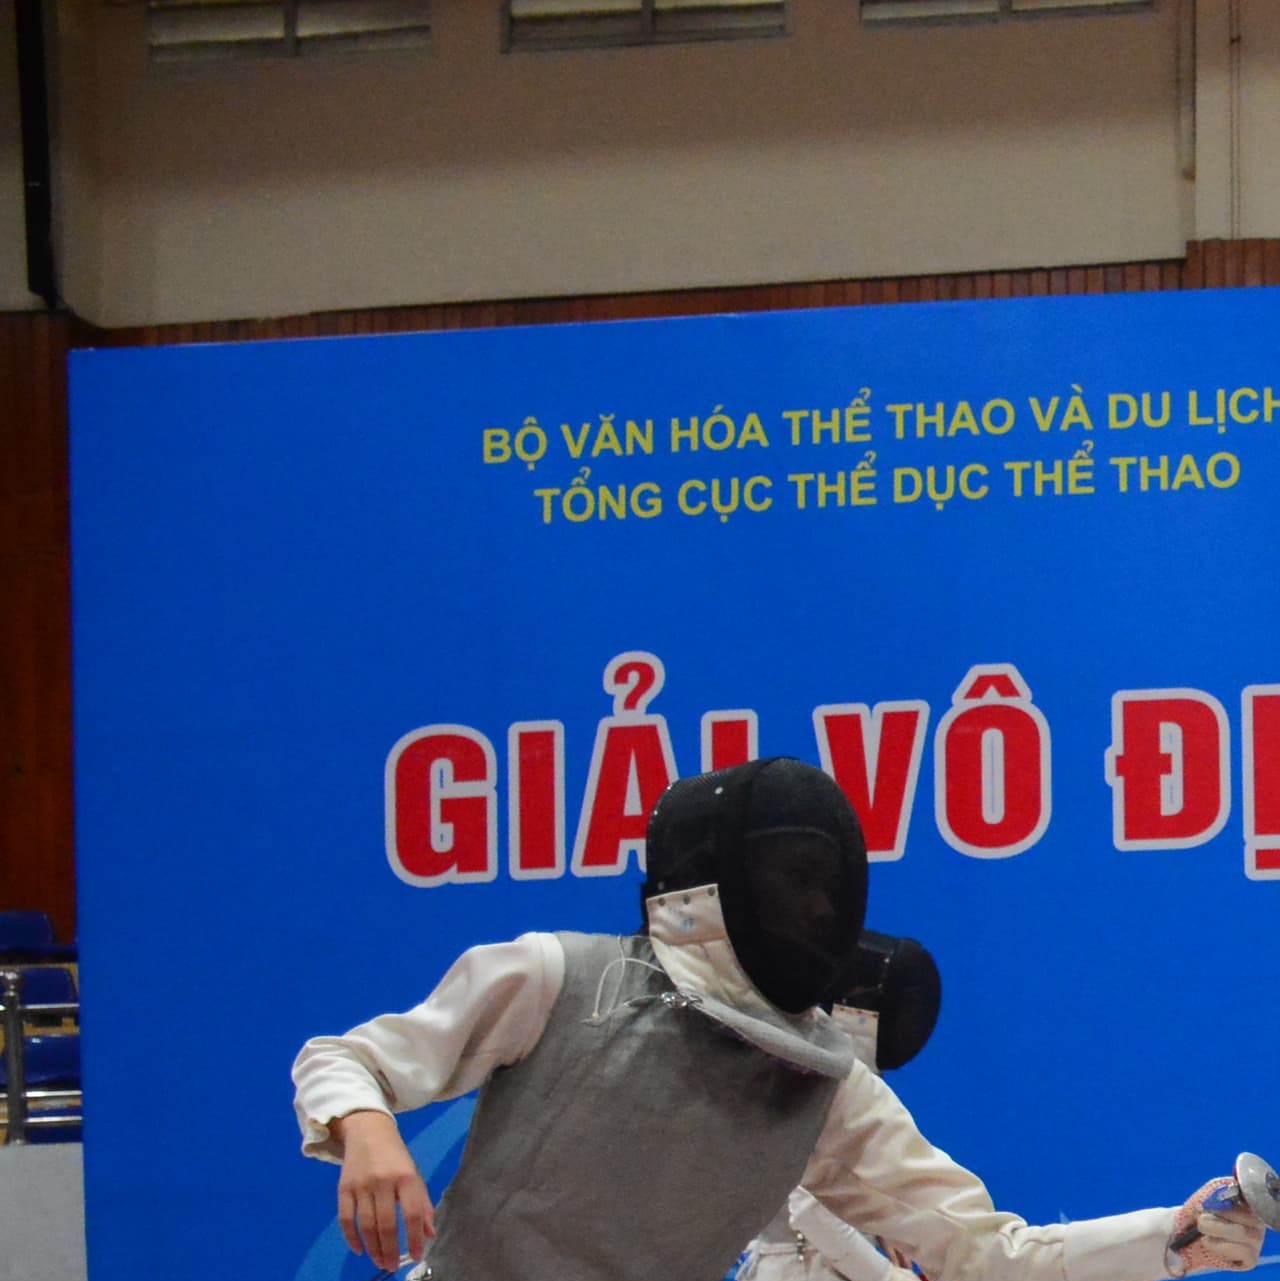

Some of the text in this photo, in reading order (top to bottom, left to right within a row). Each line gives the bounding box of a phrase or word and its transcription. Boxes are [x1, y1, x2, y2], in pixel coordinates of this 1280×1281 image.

[483, 416, 547, 470] BỘ
[560, 413, 653, 458] VĂN
[671, 404, 769, 452] HÓA
[782, 387, 872, 446] THỂ
[886, 398, 1015, 439] THAO
[1029, 383, 1094, 432] VÀ
[1108, 391, 1170, 429] DU
[534, 440, 1241, 524] TỔNG CỤC THỂ DỤC THỂ THAO
[813, 663, 1052, 862] VÔ
